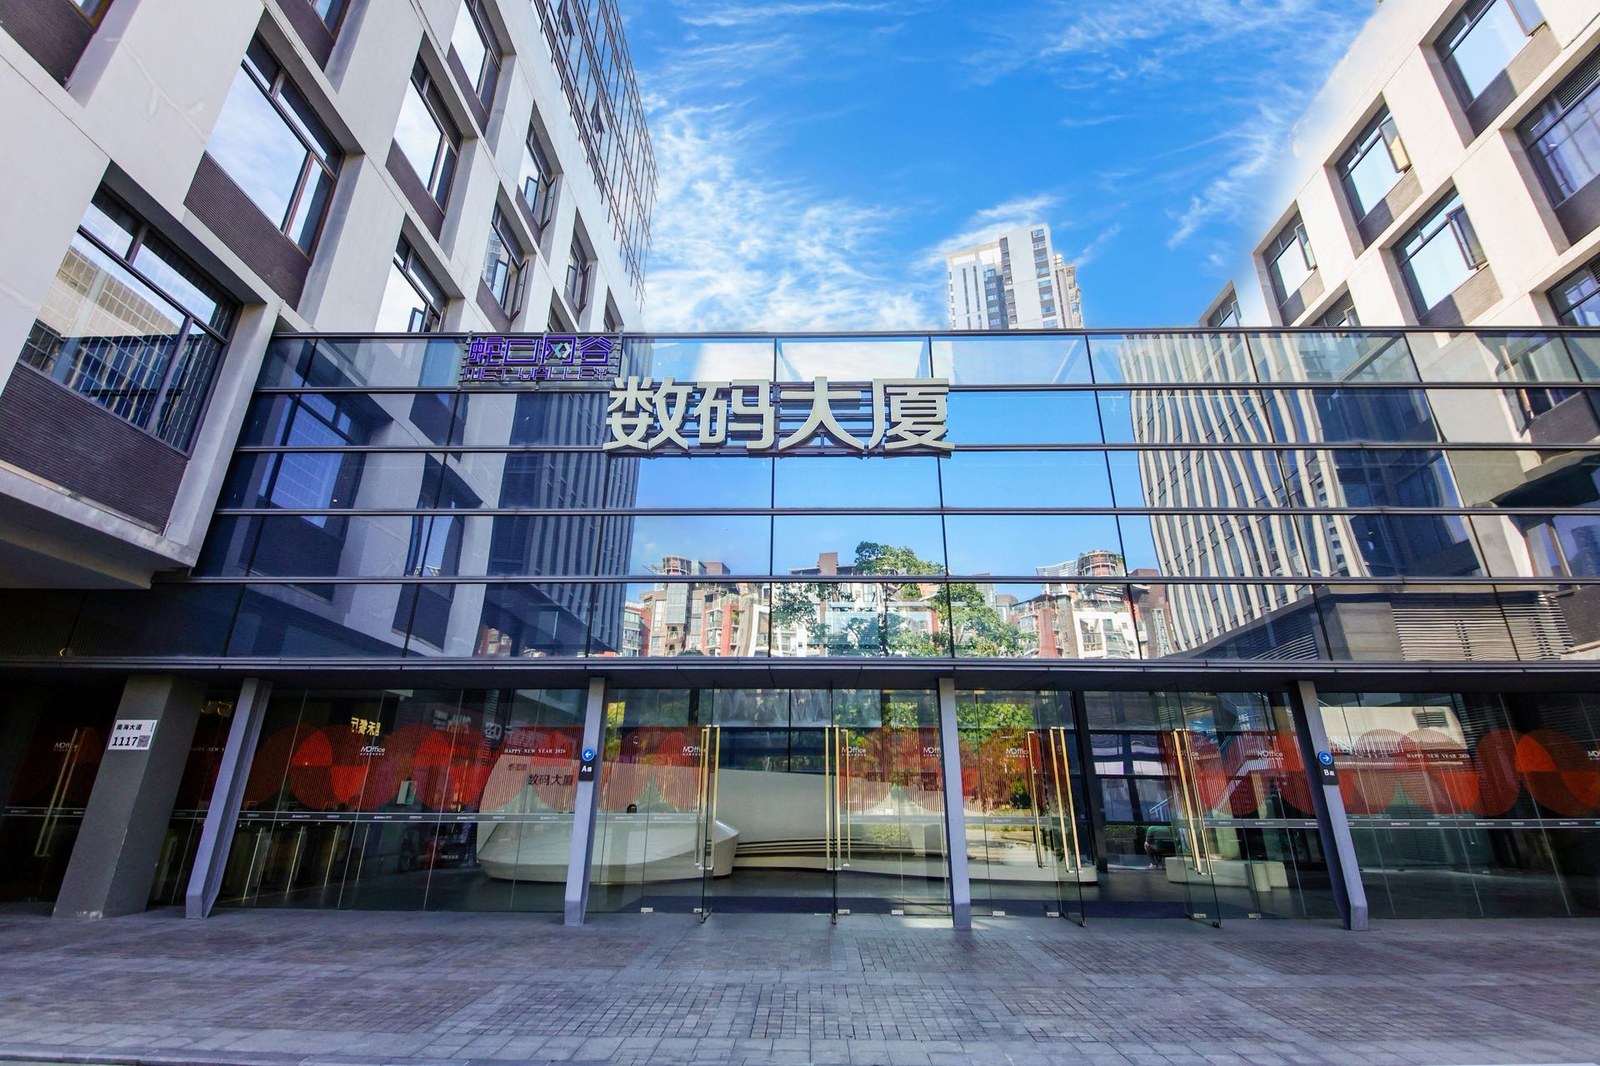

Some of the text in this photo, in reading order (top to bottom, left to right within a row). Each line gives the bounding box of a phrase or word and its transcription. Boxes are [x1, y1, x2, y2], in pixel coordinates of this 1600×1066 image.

[464, 365, 609, 381] NET VALLEY
[603, 376, 955, 453] 数码大厦
[111, 736, 139, 747] 1117
